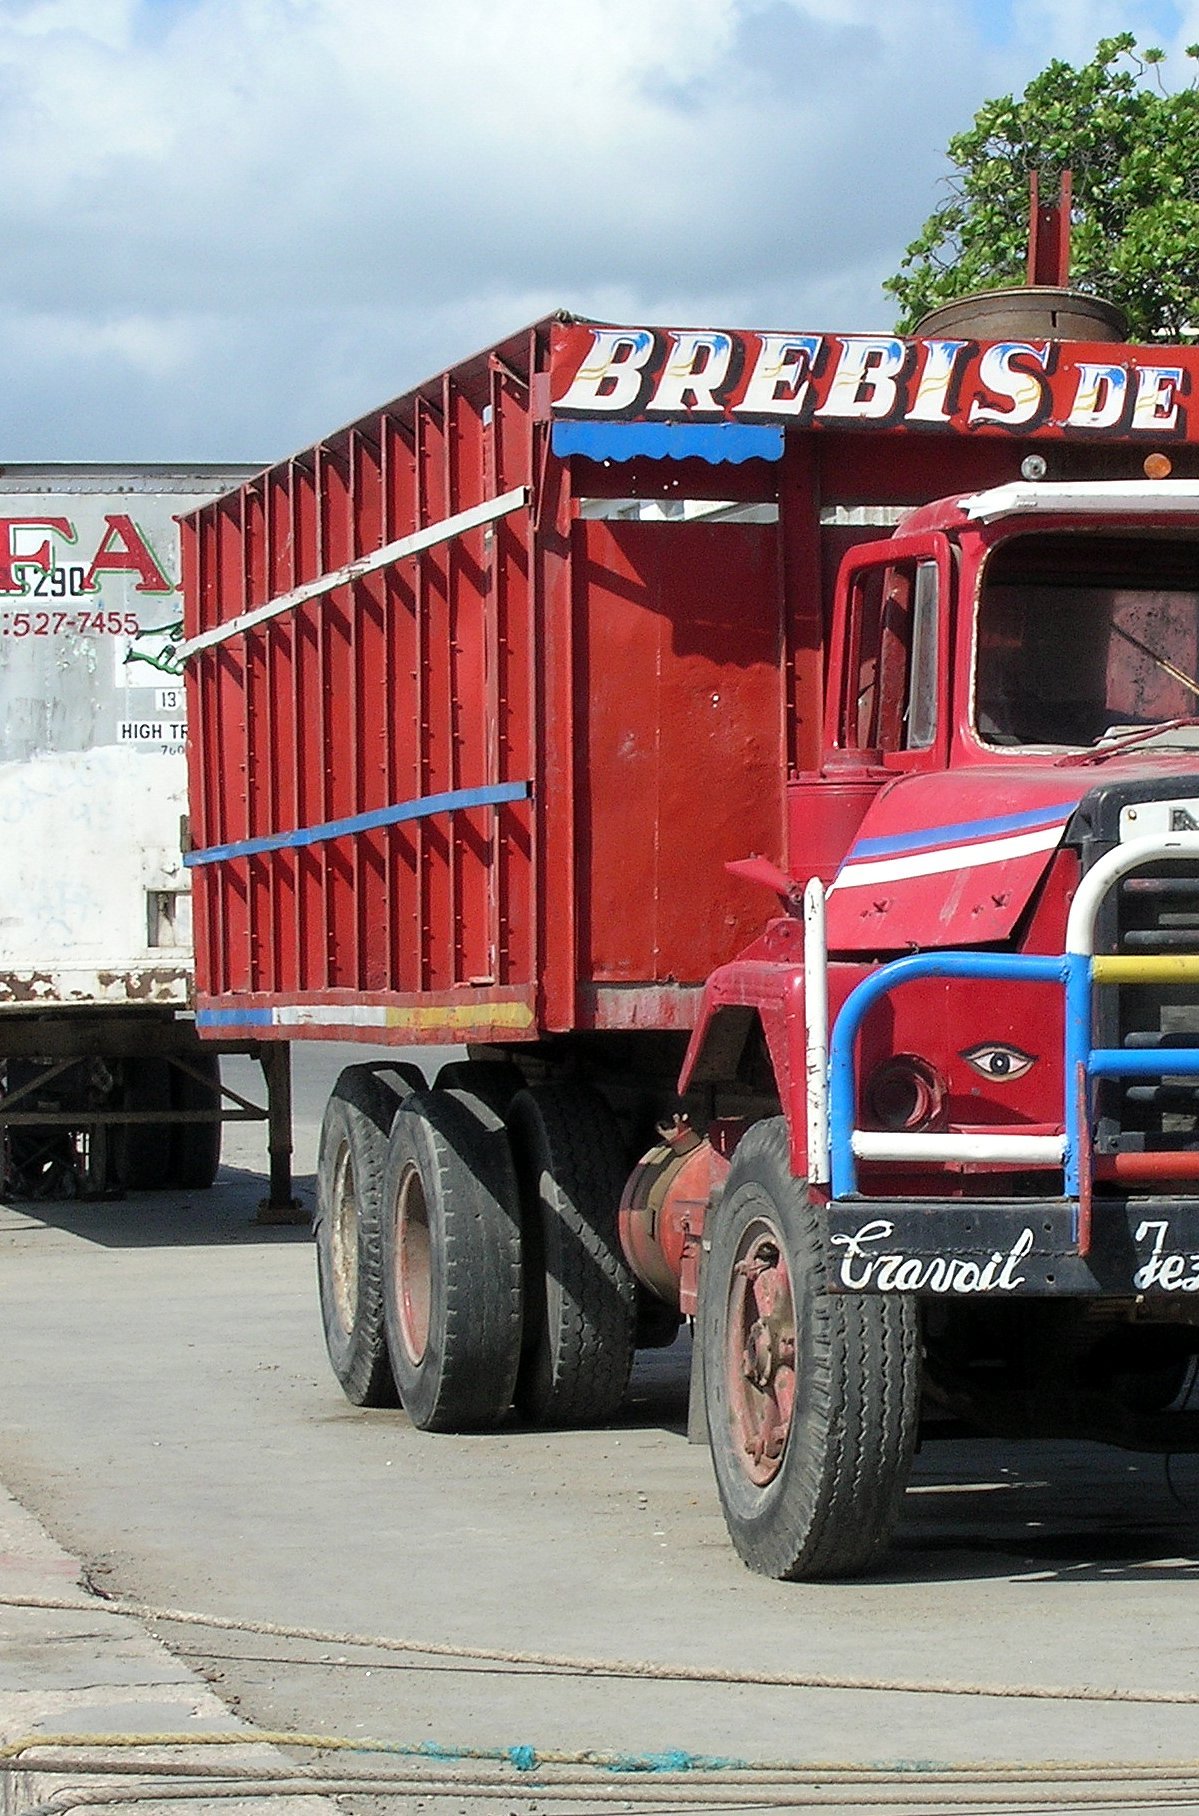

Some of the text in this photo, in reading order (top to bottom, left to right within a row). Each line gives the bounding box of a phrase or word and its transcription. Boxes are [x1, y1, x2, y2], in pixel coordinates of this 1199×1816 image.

[552, 329, 1050, 425] BREBIS
[1067, 362, 1183, 430] DE
[122, 724, 162, 739] HIGH
[831, 1219, 1034, 1293] Travail
